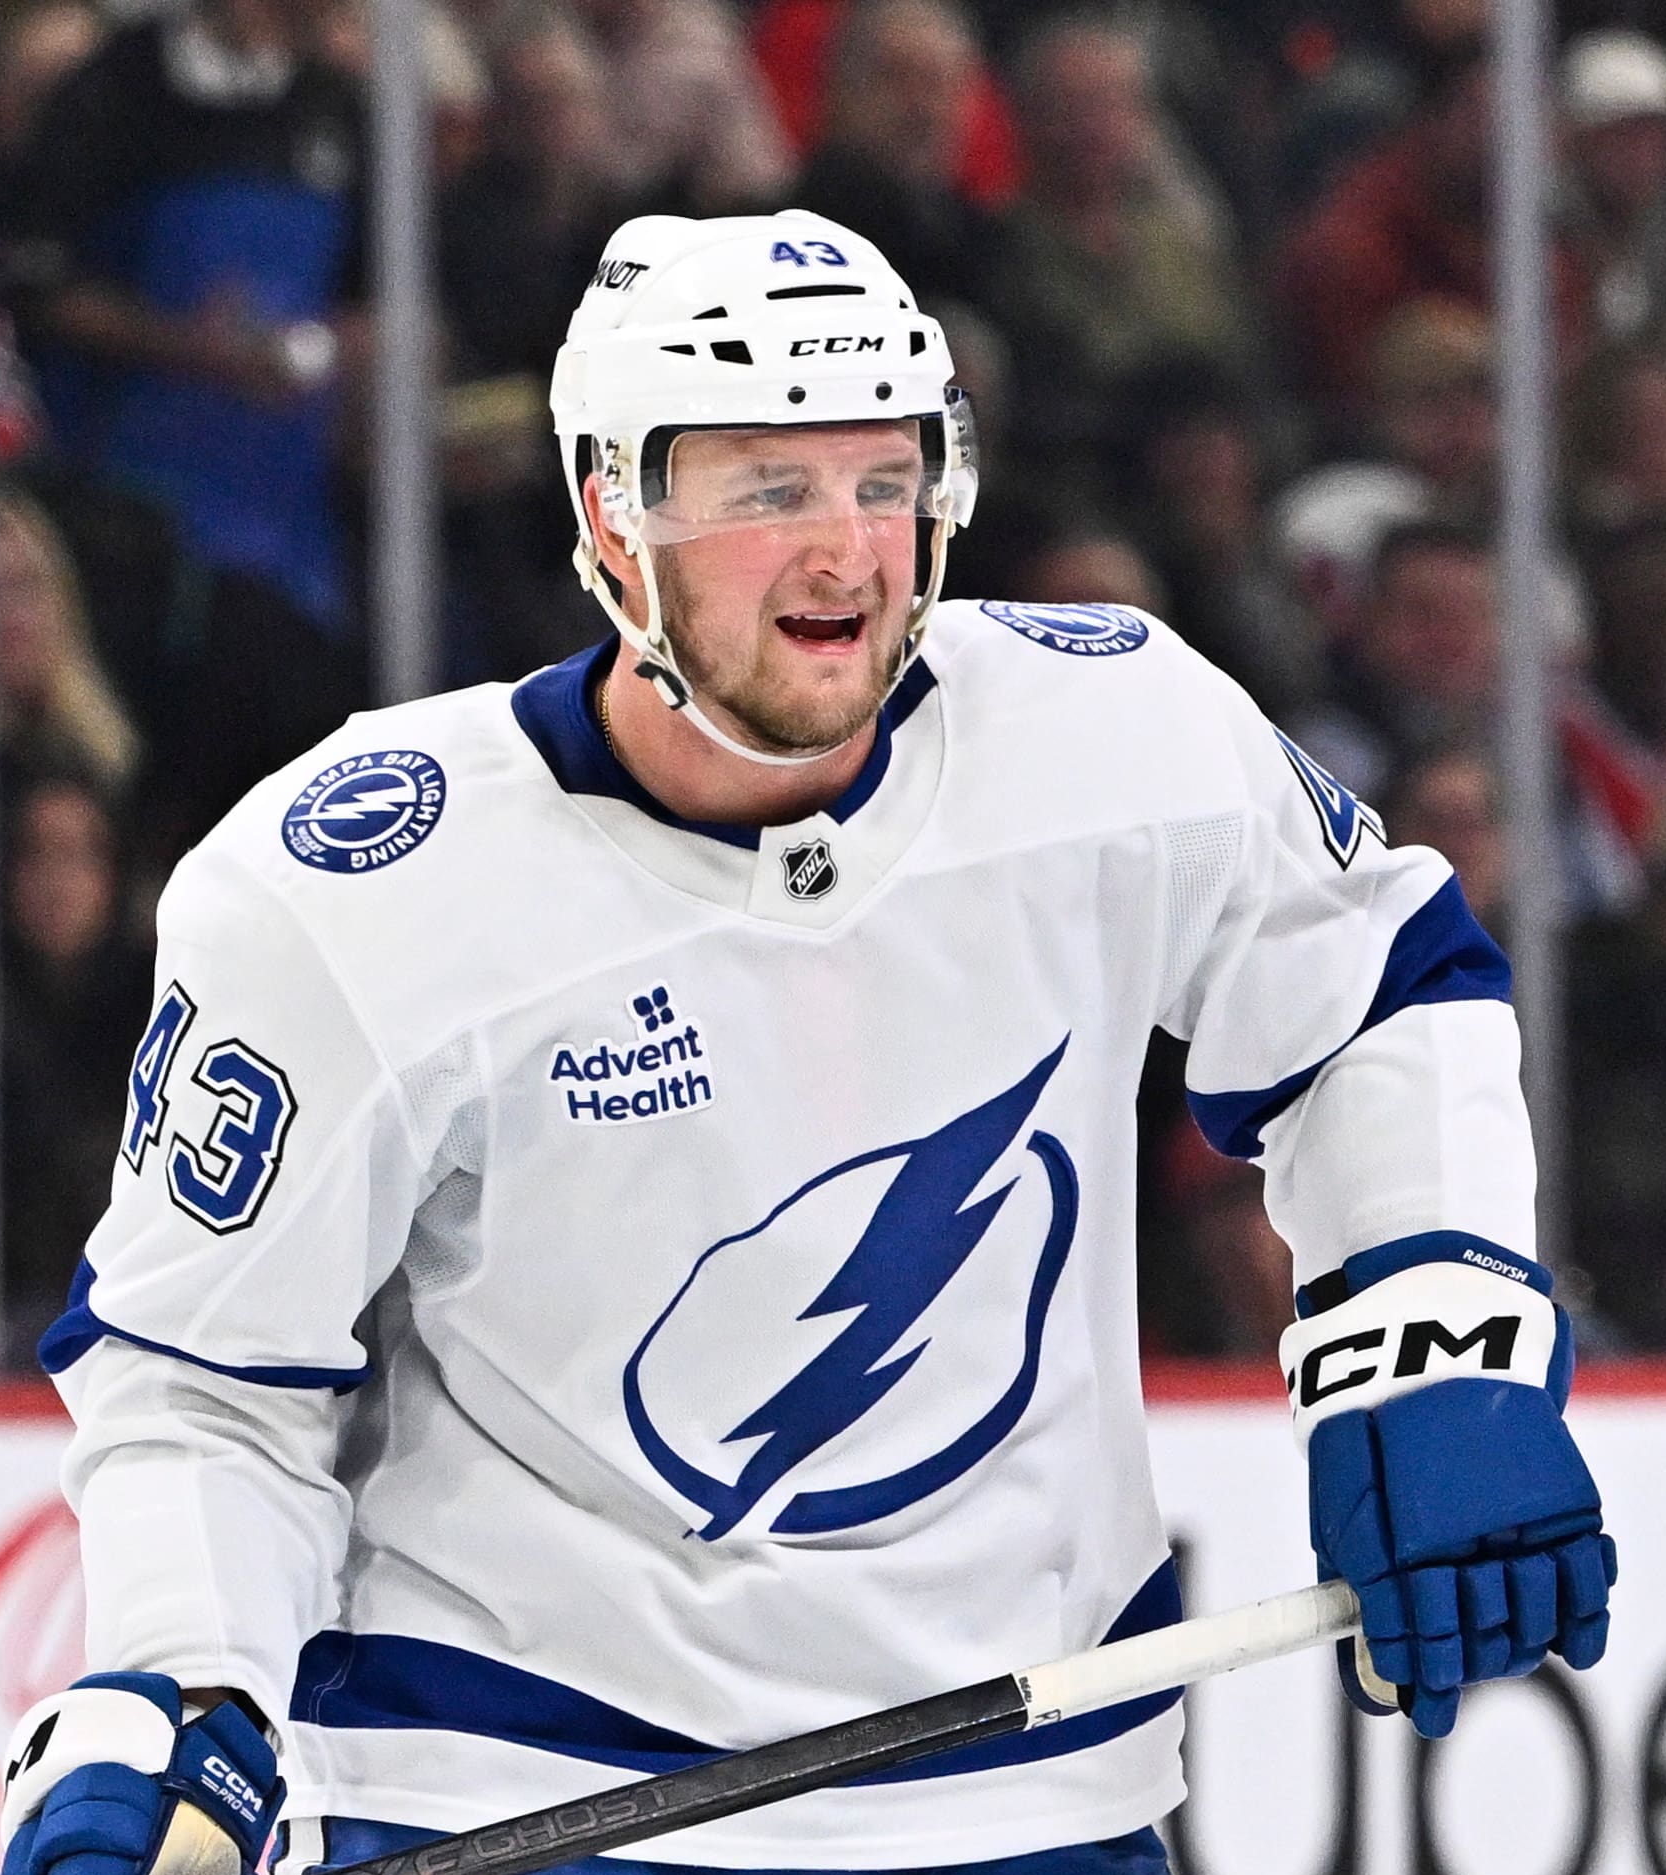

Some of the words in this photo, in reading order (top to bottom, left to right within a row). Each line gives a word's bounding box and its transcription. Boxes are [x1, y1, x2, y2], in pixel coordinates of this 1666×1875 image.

[770, 241, 849, 268] 43
[789, 336, 884, 357] CCM
[294, 755, 374, 807] TAMPA
[382, 752, 428, 770] BAY
[349, 769, 442, 869] LIGHTNING
[795, 851, 826, 892] NHL
[550, 1025, 703, 1082] Advent
[121, 978, 299, 1236] 43
[567, 1070, 712, 1120] Health
[1462, 1248, 1530, 1283] RADDYSH
[1286, 1314, 1522, 1408] CM
[202, 1755, 264, 1814] CCM
[216, 1786, 243, 1811] PRO
[472, 1777, 675, 1860] GHOST
